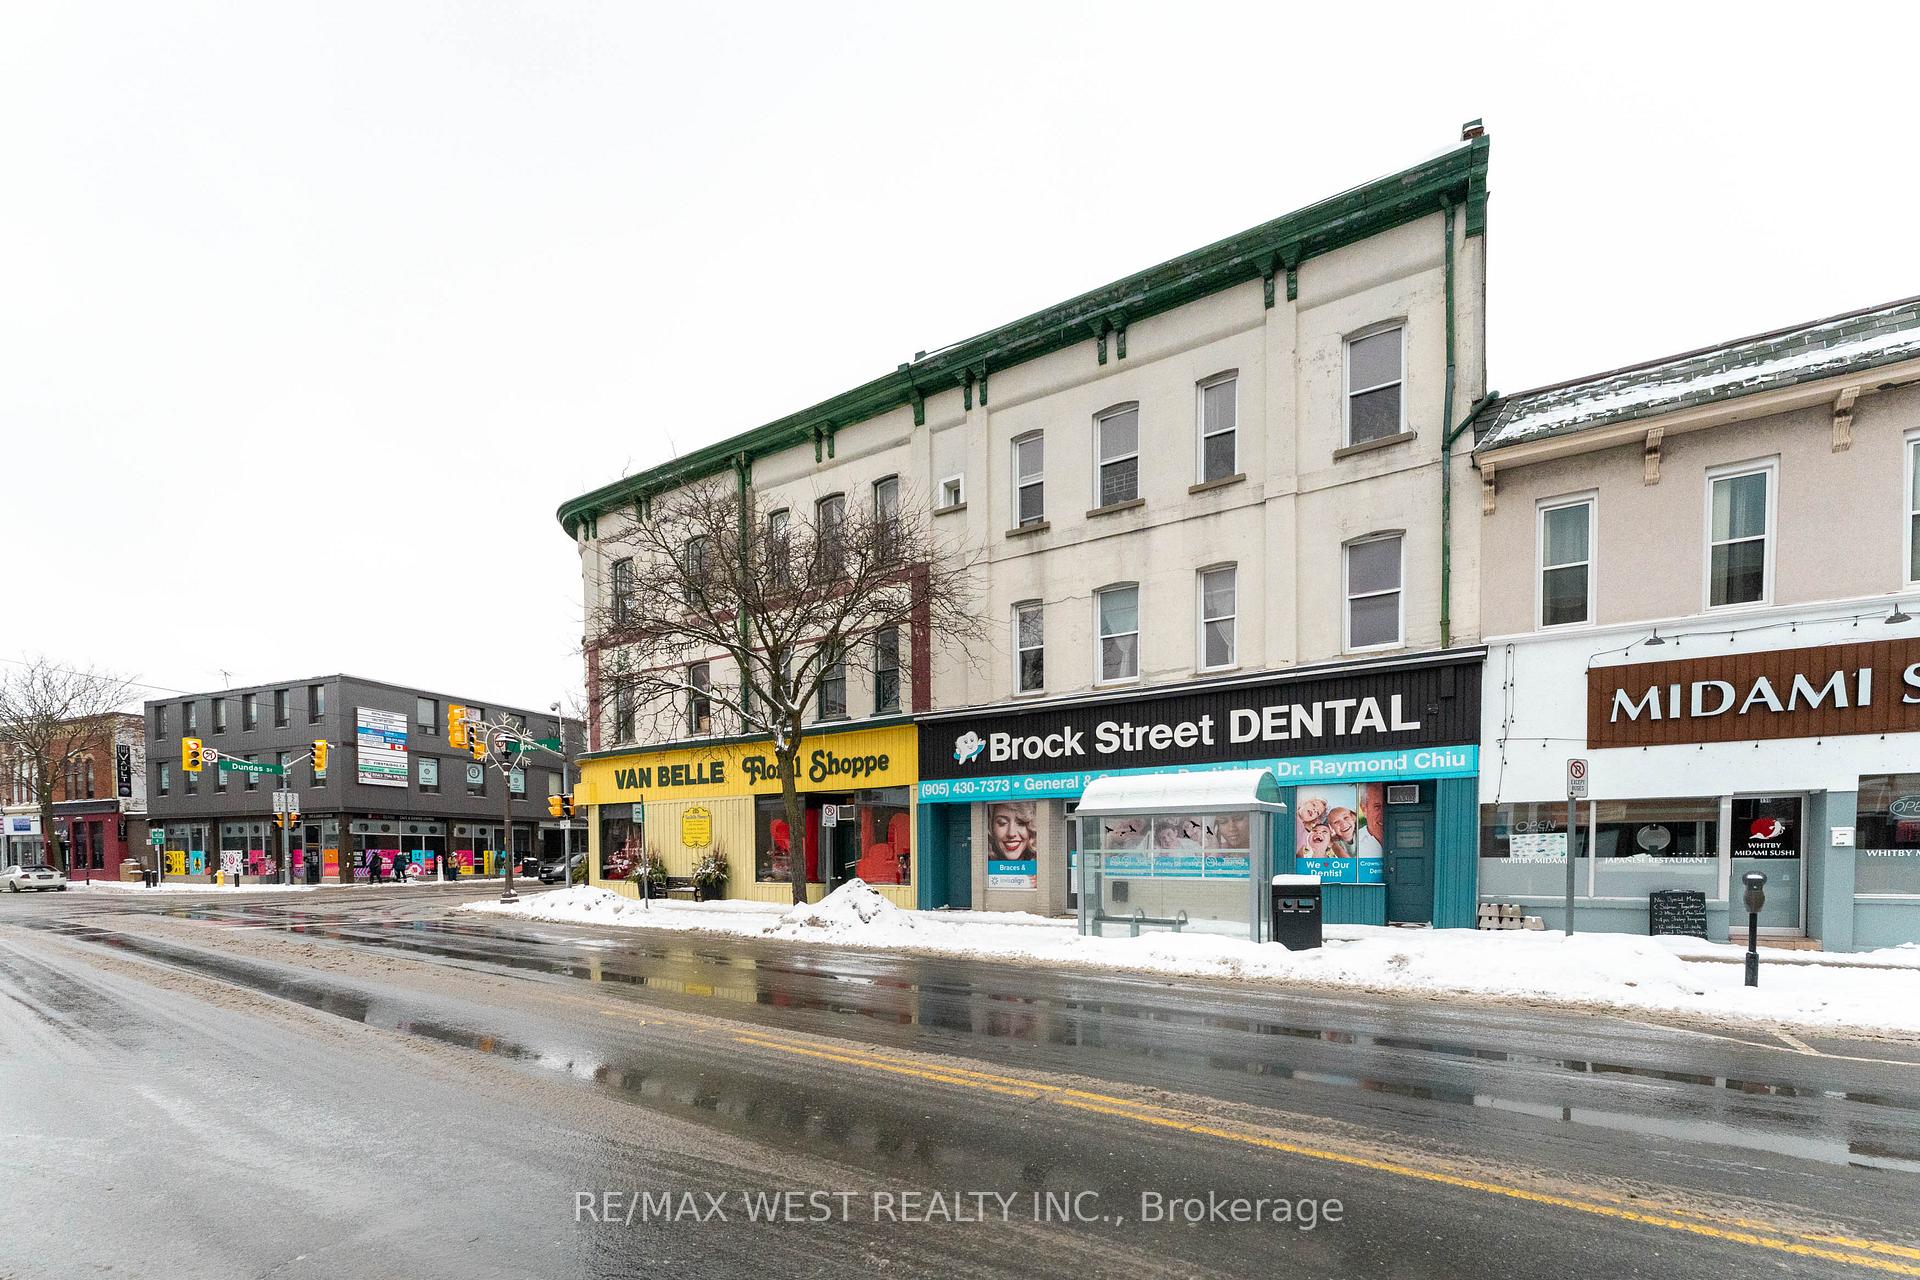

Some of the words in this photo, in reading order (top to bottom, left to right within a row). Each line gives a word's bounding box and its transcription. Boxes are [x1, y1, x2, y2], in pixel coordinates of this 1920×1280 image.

[1610, 668, 1872, 723] MIDAMI
[990, 726, 1086, 762] Brock
[1095, 714, 1214, 754] Street
[1230, 694, 1421, 744] DENTAL
[232, 763, 264, 772] Dundas
[614, 767, 652, 790] VAN
[657, 761, 725, 787] BELLE
[742, 755, 802, 786] Florl
[809, 749, 889, 783] Shoppe
[922, 783, 949, 797] (905)
[952, 780, 1010, 794] 430-7373
[1024, 775, 1079, 790] General
[1278, 761, 1303, 777] Dr.
[1309, 755, 1407, 777] Raymond
[1414, 751, 1465, 769] Chiu
[1515, 819, 1557, 832] OPEN
[1866, 849, 1913, 857] WHITBY
[1306, 861, 1321, 869] We
[1332, 861, 1350, 869] Our
[1311, 869, 1343, 877] Dentist
